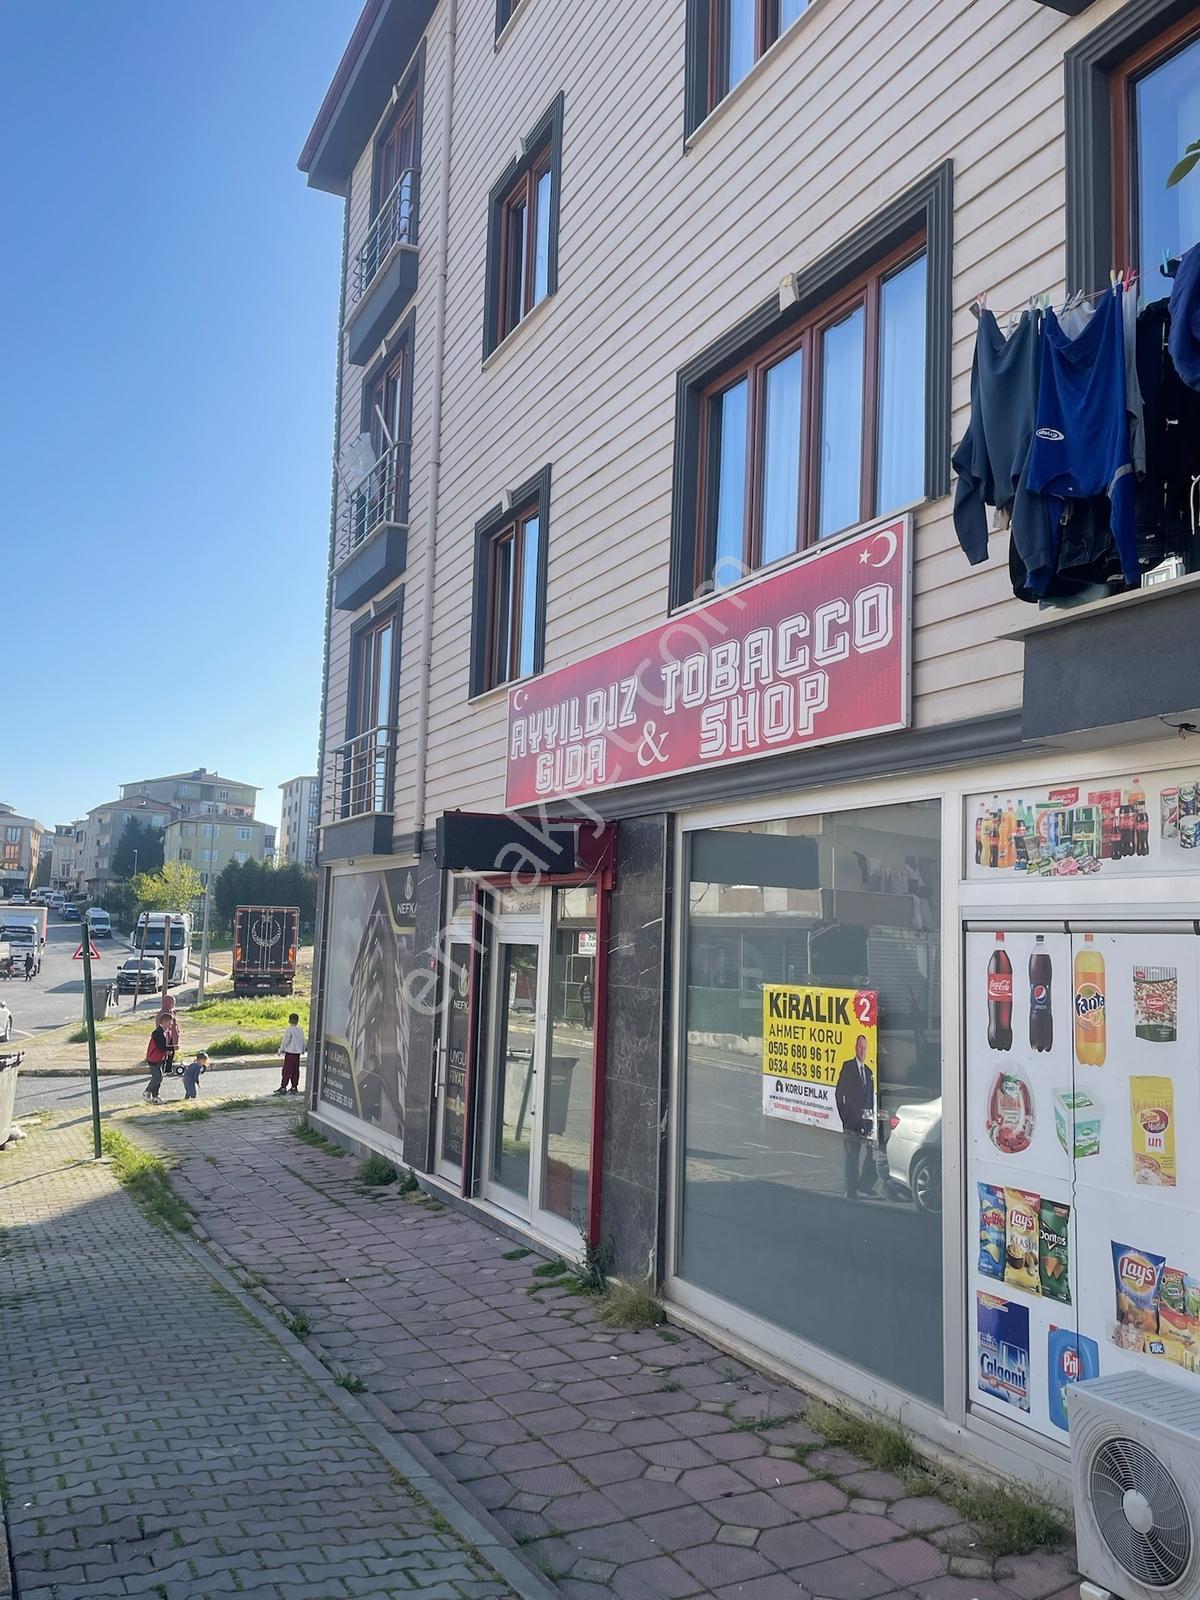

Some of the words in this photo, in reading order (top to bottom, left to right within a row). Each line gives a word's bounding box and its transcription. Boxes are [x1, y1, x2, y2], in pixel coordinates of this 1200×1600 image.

[511, 675, 638, 760] AYYILDIZ
[661, 582, 893, 716] TOBACCO
[699, 670, 829, 759] SHOP
[535, 736, 607, 795] GIDA
[636, 720, 670, 767] &
[859, 997, 871, 1022] 2
[769, 1023, 806, 1040] AHMET
[809, 1028, 843, 1045] KORU
[768, 1041, 788, 1056] 0505
[791, 1044, 807, 1059] 680
[810, 1047, 821, 1061] 96
[825, 1048, 836, 1063] 17
[768, 1058, 788, 1074] 0534
[791, 1061, 807, 1077] 453
[810, 1064, 821, 1079] 96
[825, 1066, 836, 1082] 17
[1148, 1137, 1162, 1147] un
[981, 1352, 1026, 1390] Calgonit
[1064, 1354, 1078, 1376] Pril
